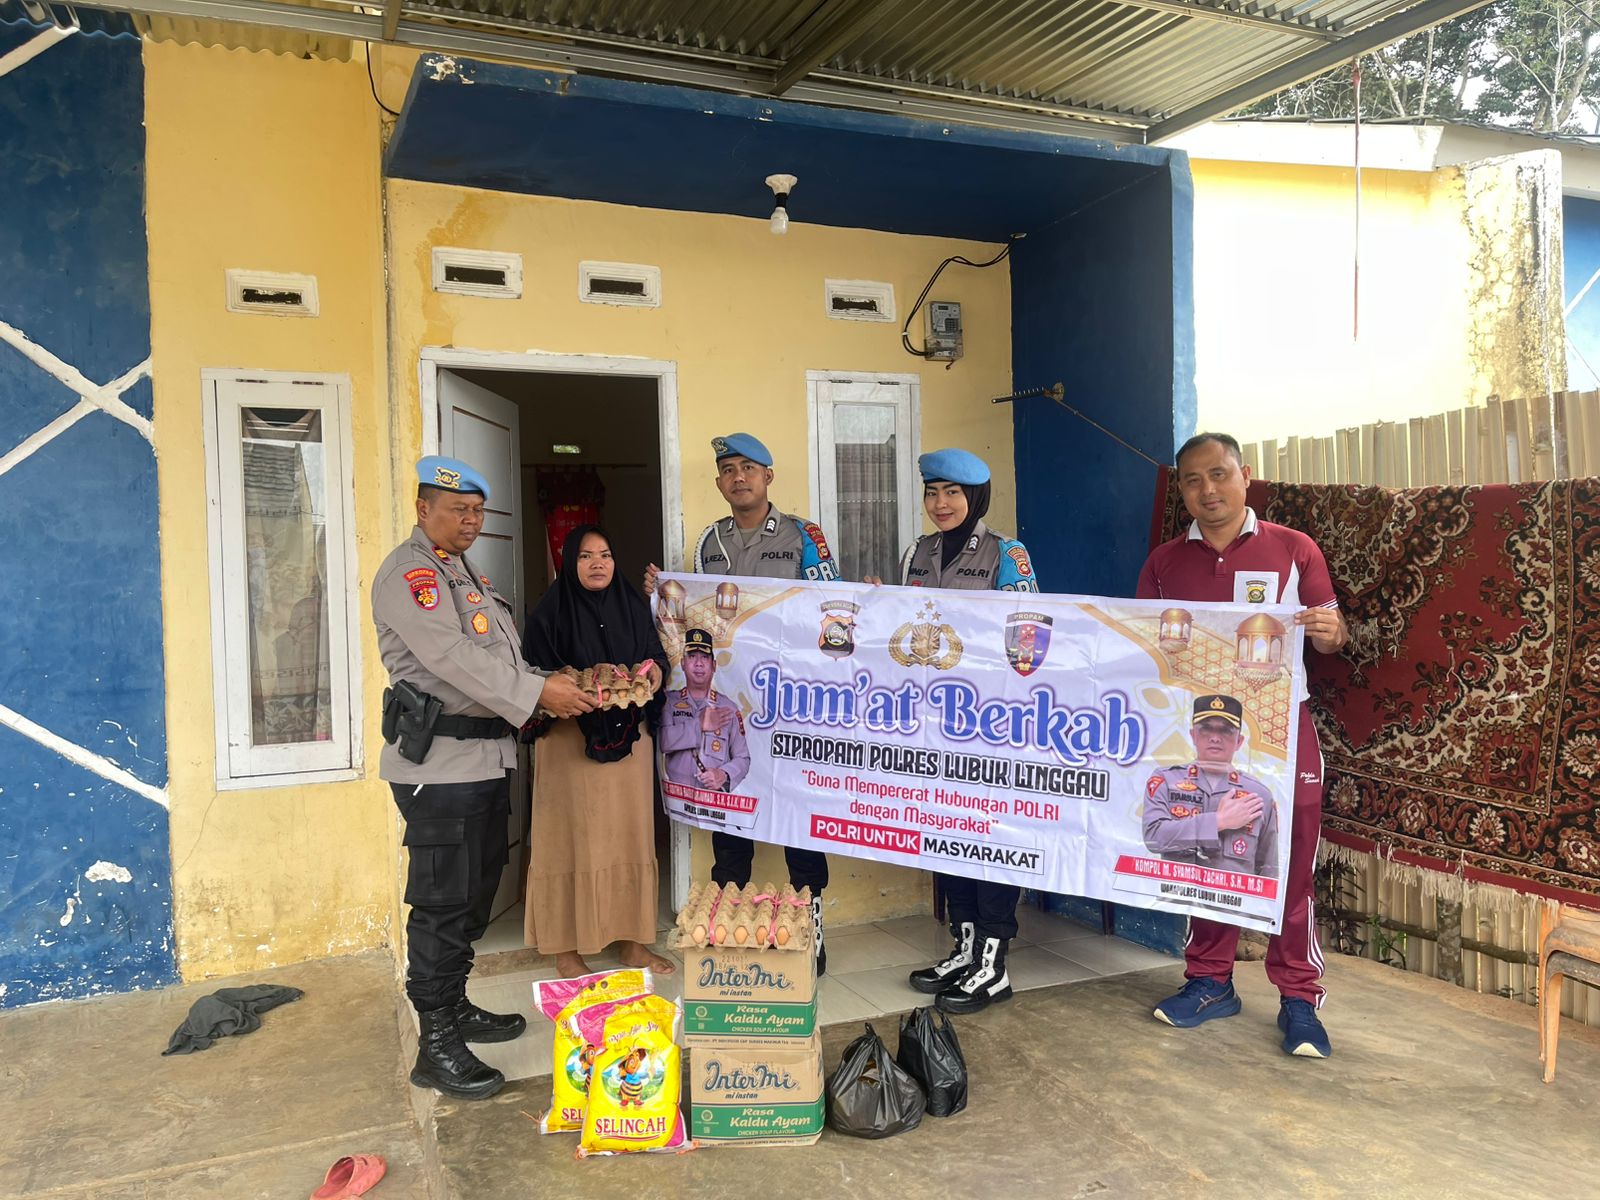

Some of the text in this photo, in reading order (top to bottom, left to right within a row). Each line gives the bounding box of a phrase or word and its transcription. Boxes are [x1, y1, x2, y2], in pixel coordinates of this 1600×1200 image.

[761, 551, 794, 560] POLRI
[956, 568, 990, 578] POLRI
[1014, 612, 1044, 622] PROPAM
[752, 663, 1143, 764] Jum'at Berkah
[772, 733, 1107, 799] SIPROPAM POLRES LUBUK LINGGAU
[845, 775, 930, 803] Mempererat
[934, 788, 1009, 815] Hubungan
[1013, 799, 1060, 822] POLRI
[850, 799, 899, 822] dengan
[816, 819, 1040, 870] POLRI UNTUK MASYARAKAT
[1134, 859, 1161, 875] KOMPOL
[1162, 864, 1171, 877] M.
[1198, 888, 1216, 902] LUBUK
[1217, 891, 1243, 907] LINGGAU
[730, 989, 752, 997] instan
[736, 1005, 769, 1014] Rasa
[724, 1013, 762, 1024] Kaldu
[765, 1014, 805, 1027] Ayam
[742, 1108, 775, 1116] Rasa
[595, 1116, 667, 1135] SELINCAH
[730, 1117, 768, 1127] Kaldu
[772, 1116, 811, 1128] Ayam
